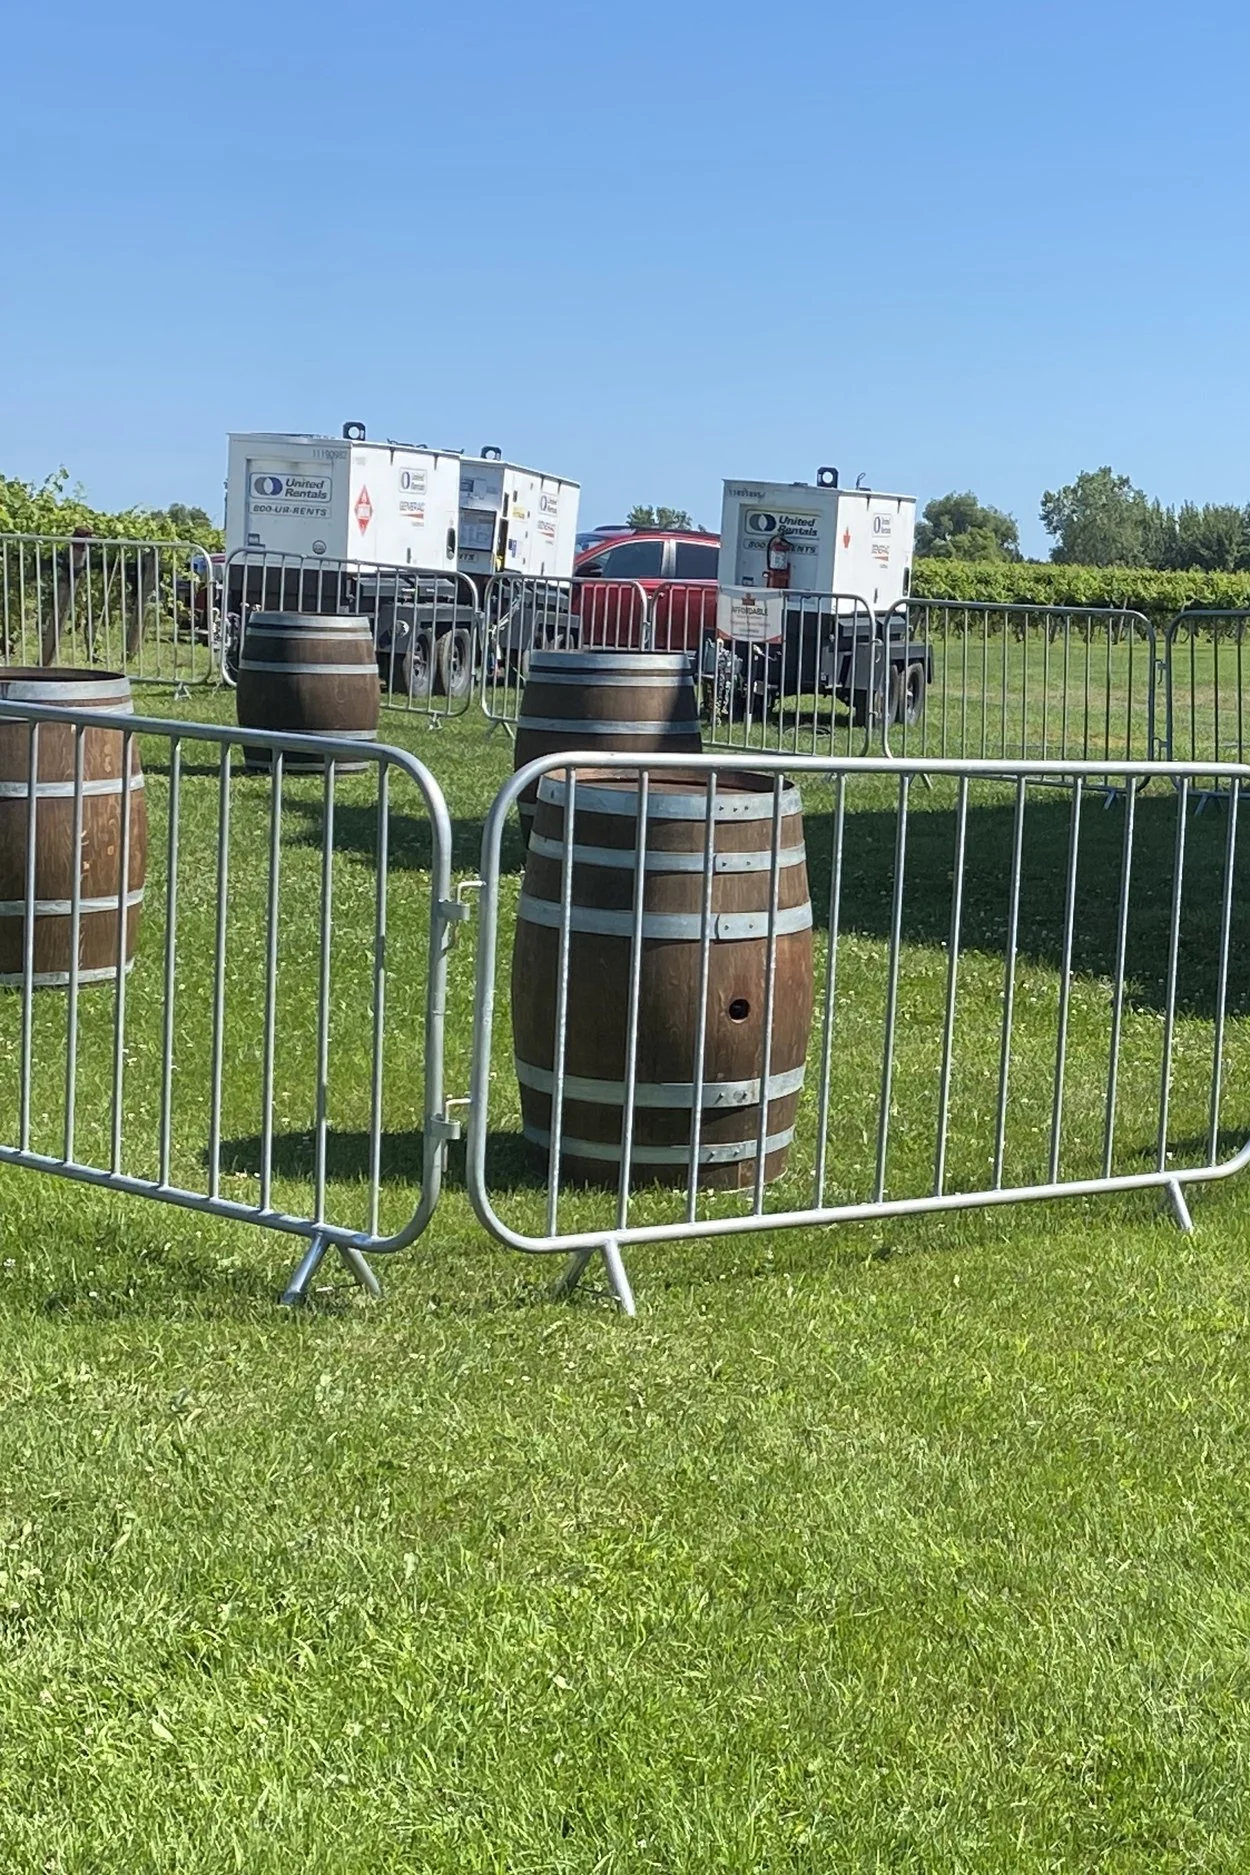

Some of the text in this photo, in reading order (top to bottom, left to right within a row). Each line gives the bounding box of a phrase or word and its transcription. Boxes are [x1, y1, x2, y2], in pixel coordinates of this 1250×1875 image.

[286, 477, 325, 489] United
[285, 488, 328, 500] Rentals
[253, 504, 328, 517] 800-UR-RENTS
[778, 515, 816, 527] United
[777, 525, 818, 537] Rentals
